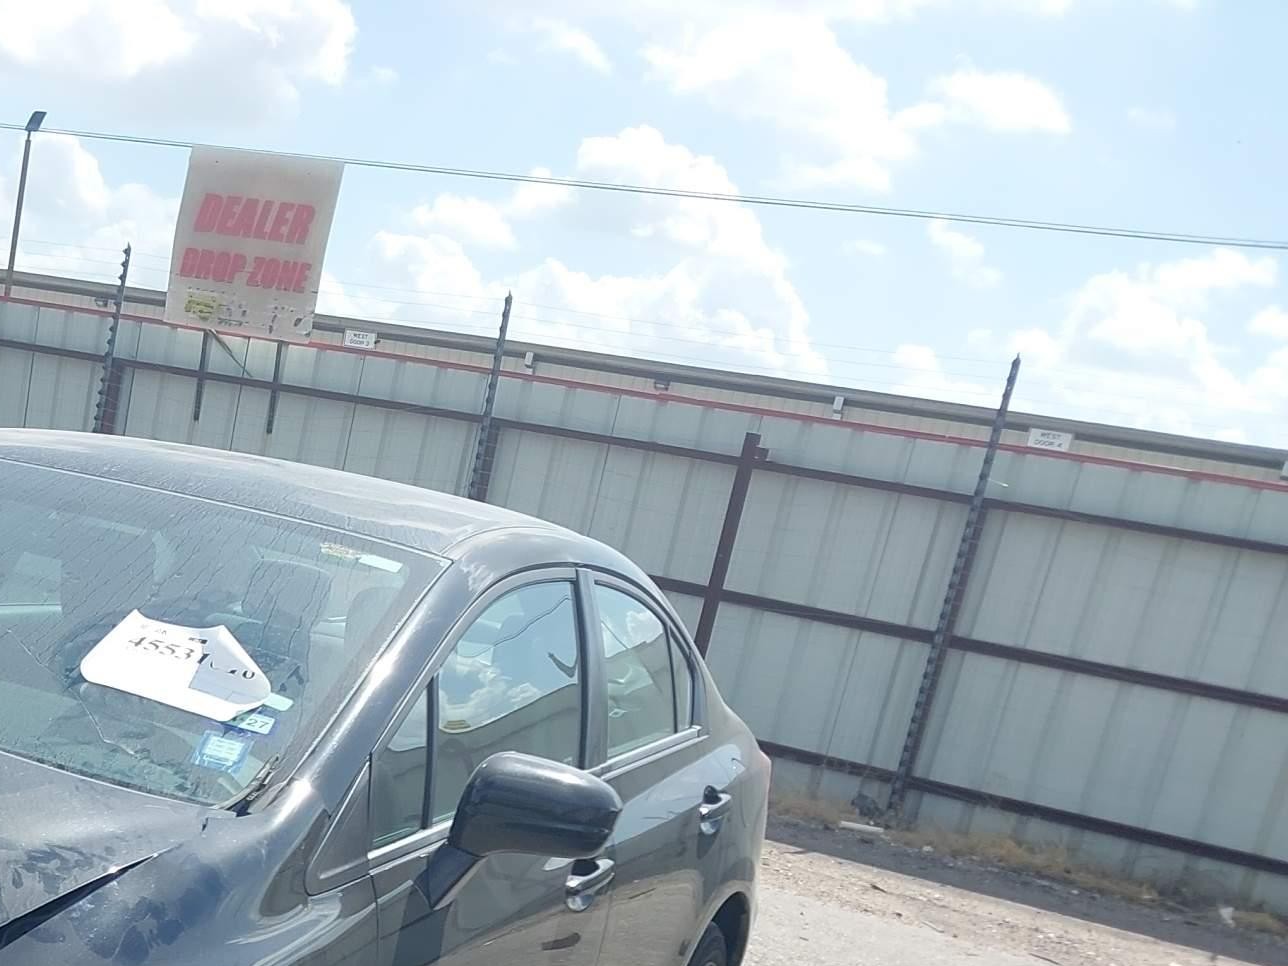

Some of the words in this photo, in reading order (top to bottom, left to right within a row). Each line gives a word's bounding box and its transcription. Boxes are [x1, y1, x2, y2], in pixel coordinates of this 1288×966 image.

[193, 192, 317, 245] DEALER
[178, 247, 248, 284] DROP
[245, 255, 313, 294] ZONE
[245, 718, 270, 730] 27
